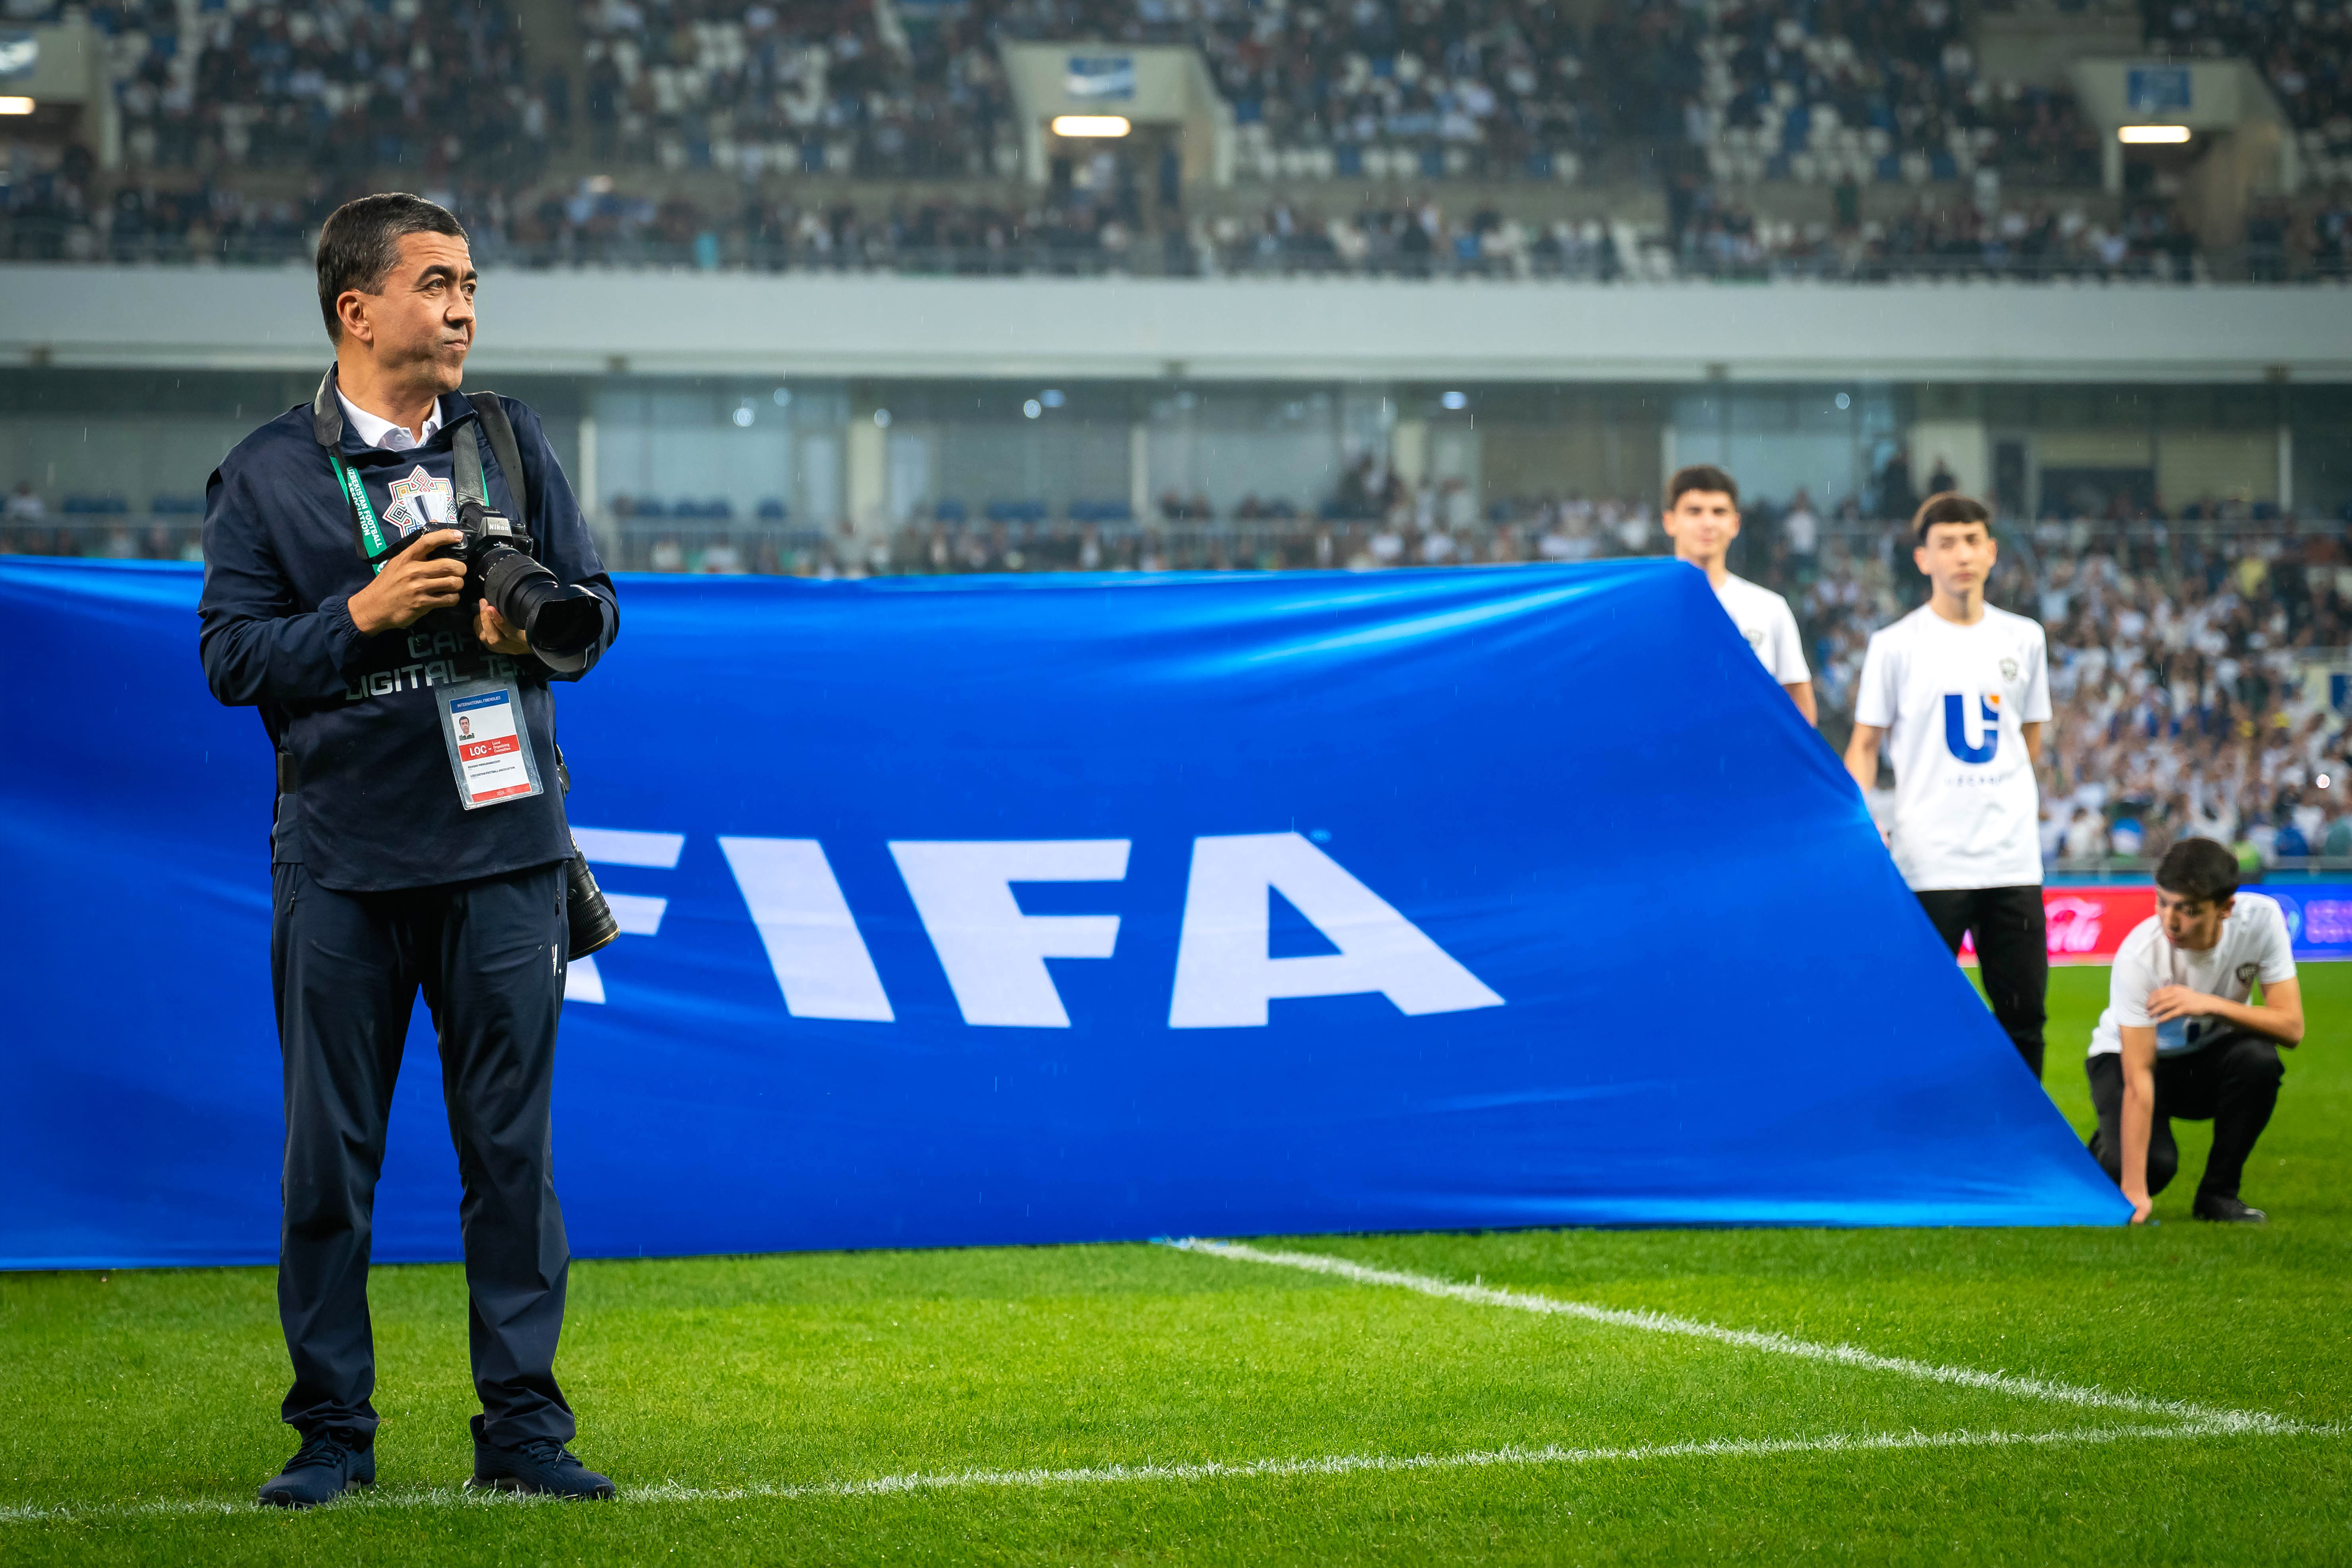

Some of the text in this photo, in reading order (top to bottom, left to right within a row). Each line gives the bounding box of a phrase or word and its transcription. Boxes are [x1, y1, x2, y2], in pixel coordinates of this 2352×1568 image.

[347, 466, 382, 549] UZBEKISTAN FOOTBALL
[457, 699, 483, 707] INTERNATIONAL
[469, 745, 487, 756] LOC
[564, 827, 1505, 1028] IFA
